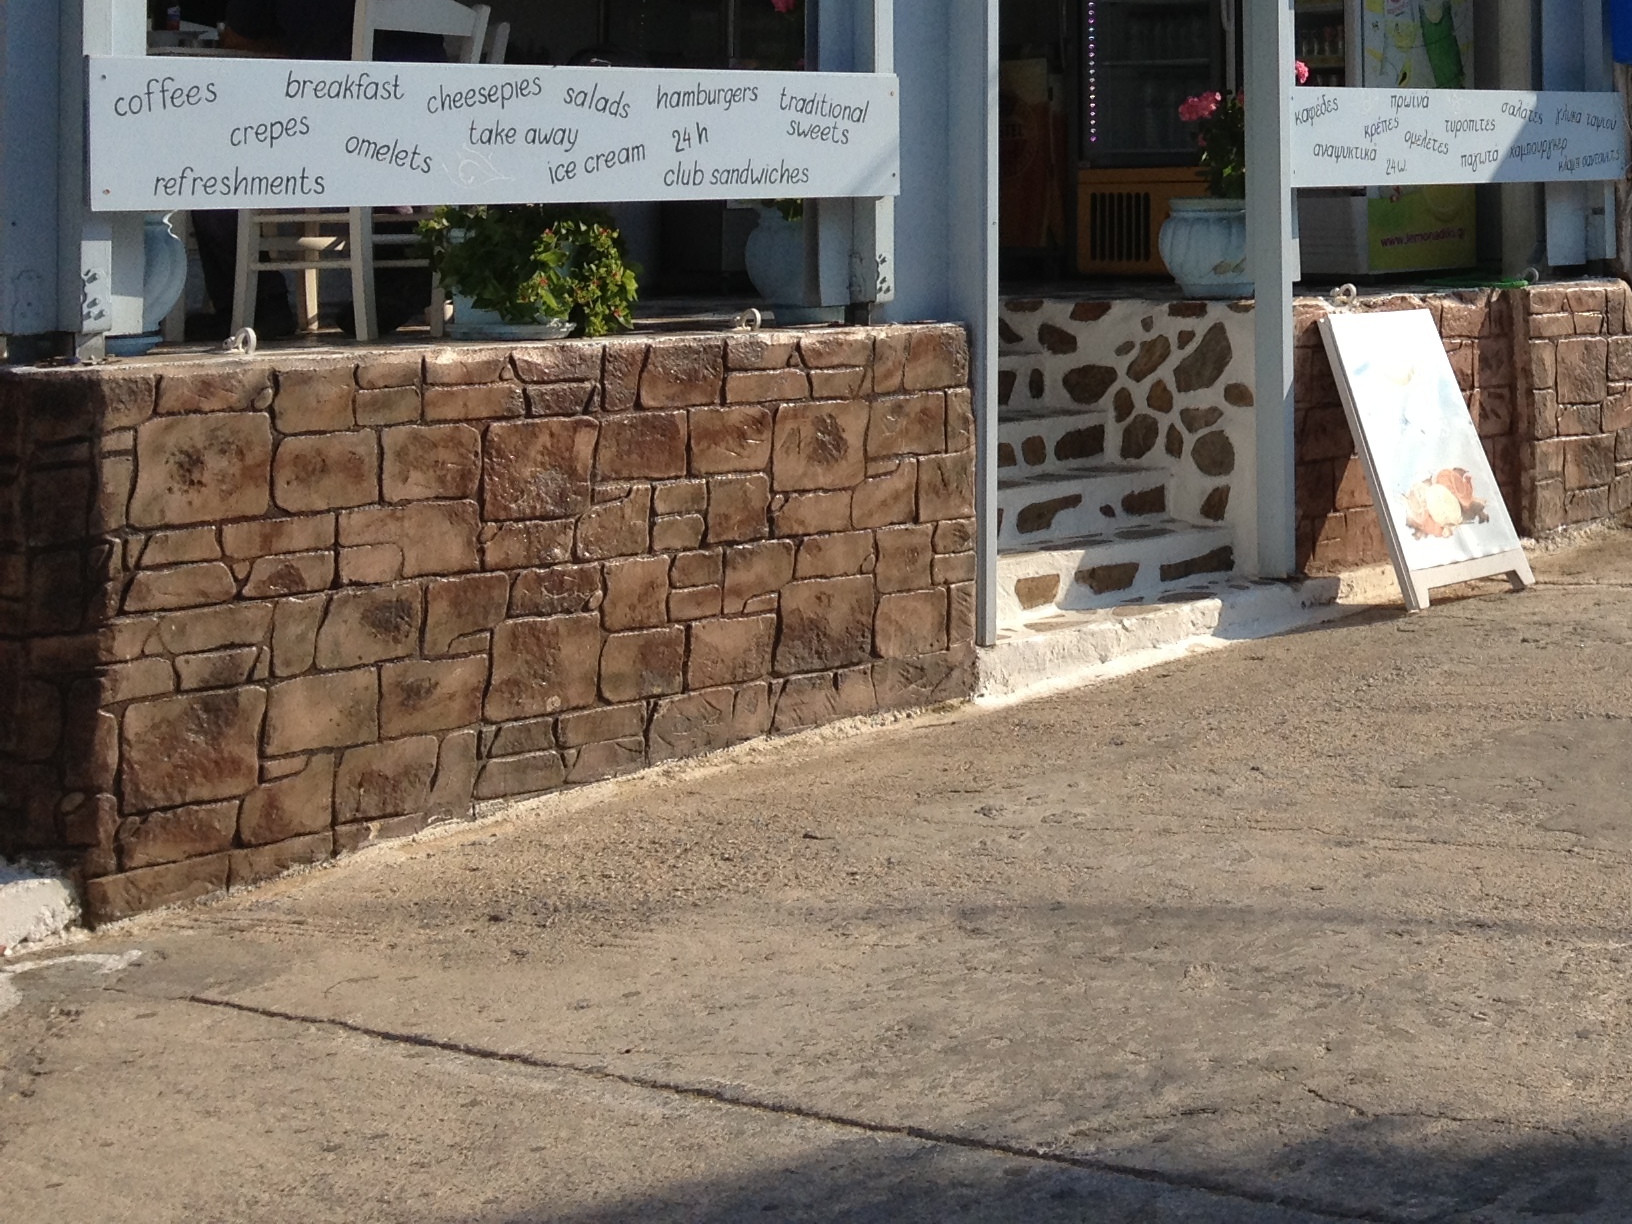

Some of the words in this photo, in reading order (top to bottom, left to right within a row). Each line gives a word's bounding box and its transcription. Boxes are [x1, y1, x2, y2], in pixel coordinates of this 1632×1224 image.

[113, 77, 217, 117] coffees
[284, 70, 404, 101] breakfast
[426, 75, 542, 115] cheesepies
[563, 84, 631, 119] salads
[656, 82, 759, 114] hamburgers
[780, 86, 870, 124] traditional
[1294, 94, 1339, 127] καφέδες
[230, 114, 310, 148] crepes
[468, 118, 517, 145] take
[524, 127, 579, 153] away
[786, 118, 849, 145] sweets
[344, 134, 433, 174] omelets
[547, 157, 577, 185] ice
[584, 142, 646, 174] cream
[153, 166, 325, 196] refreshments
[664, 160, 704, 187] club
[709, 163, 809, 186] sandwiches
